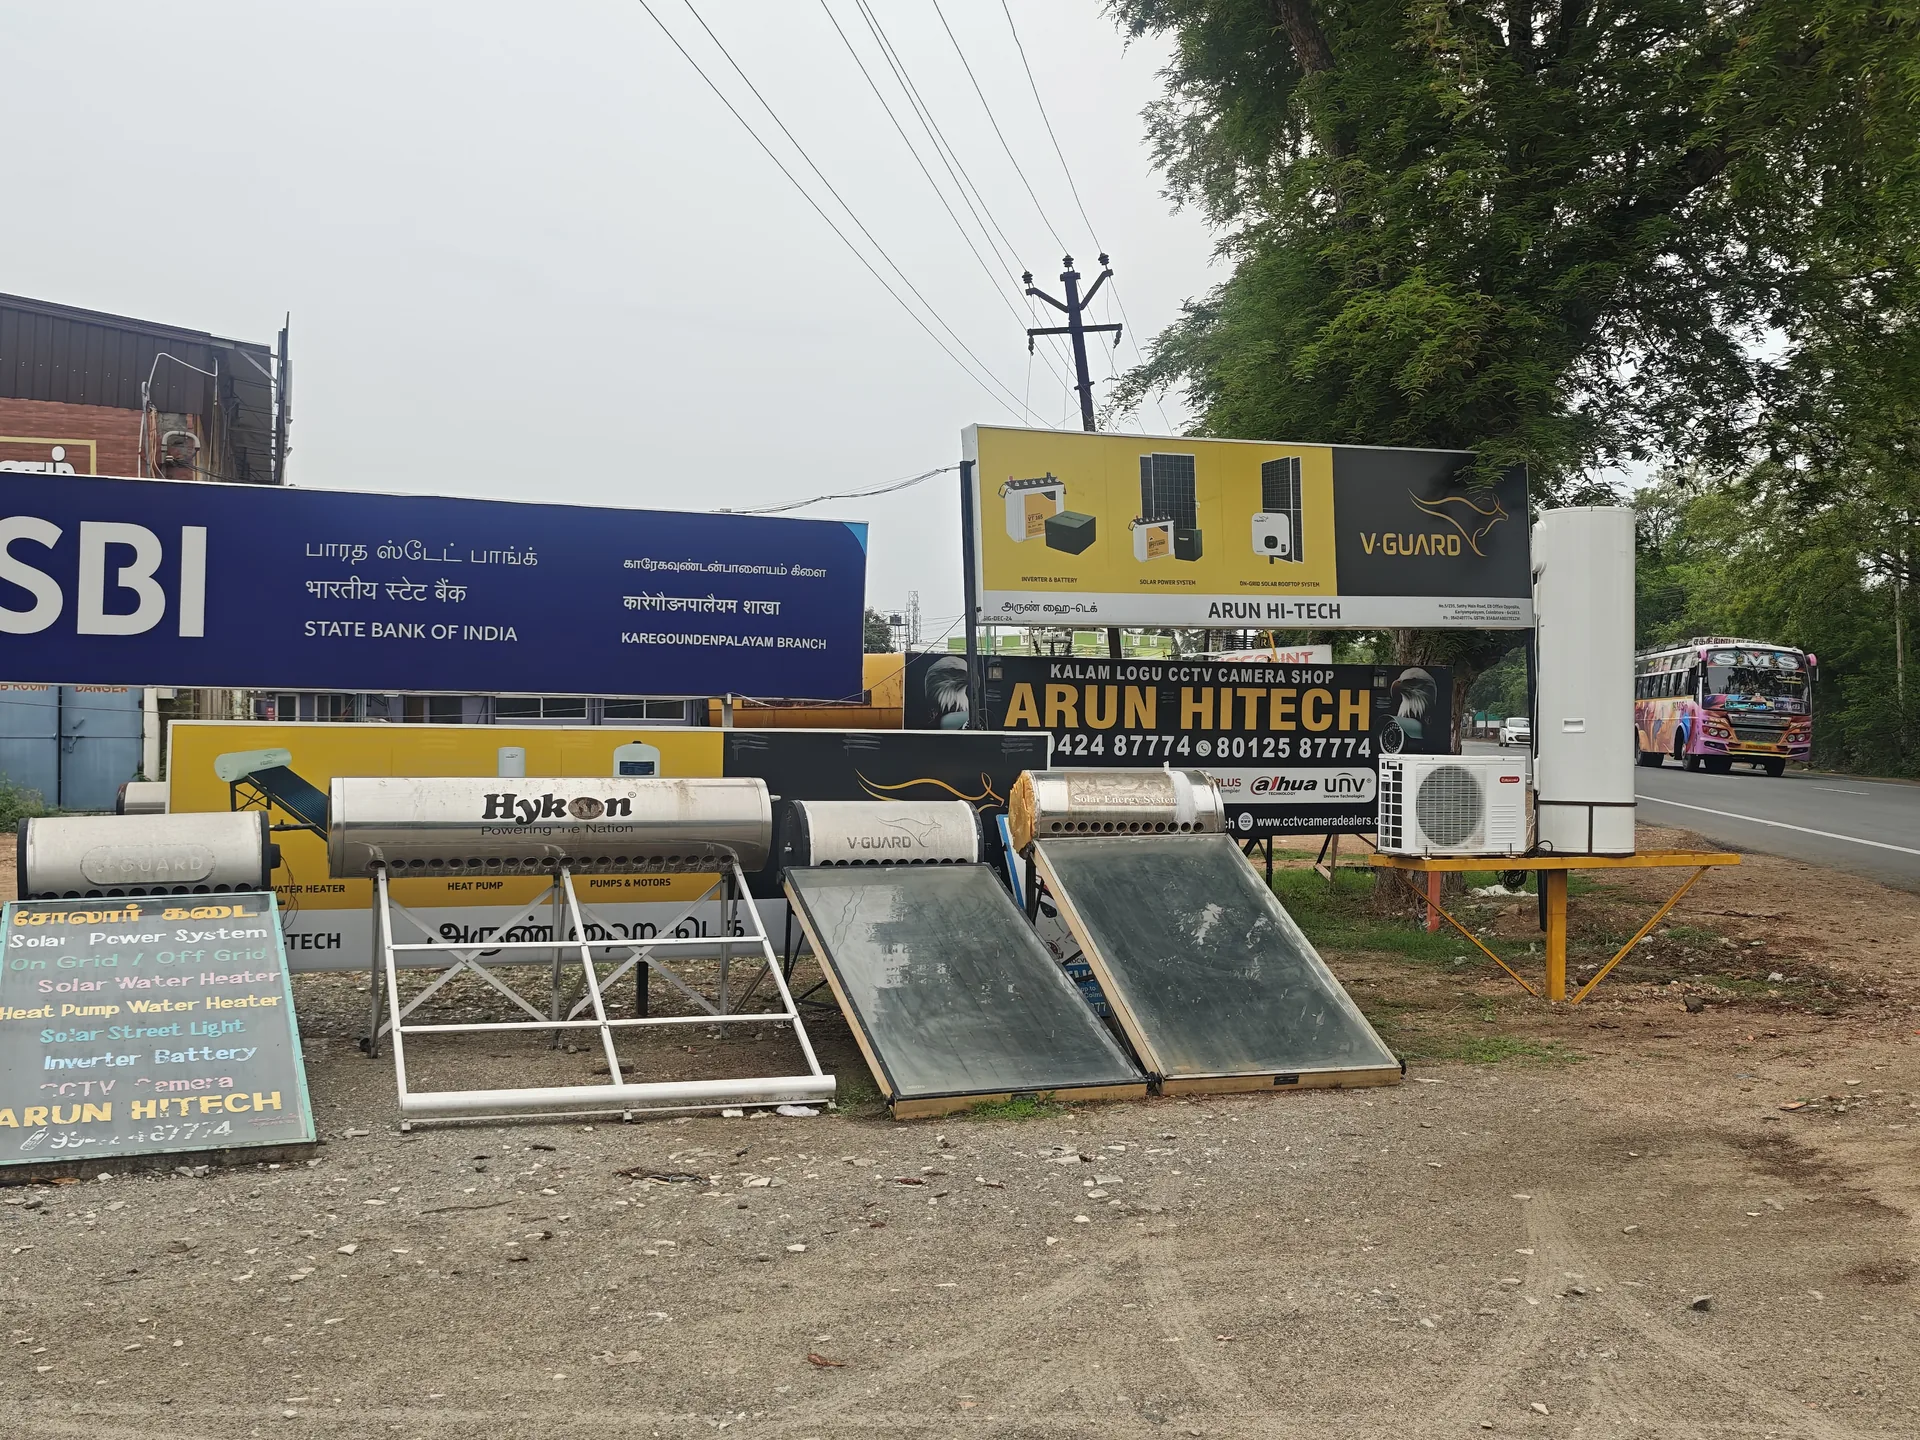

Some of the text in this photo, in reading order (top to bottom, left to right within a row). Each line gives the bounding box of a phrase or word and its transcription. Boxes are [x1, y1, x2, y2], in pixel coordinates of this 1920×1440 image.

[306, 540, 538, 566] பாரத ஸ்டேட் பாங்க்
[1360, 532, 1461, 556] V-GUARD
[0, 516, 207, 637] SBI
[790, 563, 827, 578] கிளை
[305, 575, 468, 603] भारतीय स्टेट बैंक
[743, 599, 781, 615] शाखा
[1001, 600, 1041, 615] அருண்
[1208, 602, 1342, 620] ARUN HI-TECH
[304, 620, 518, 641] STATE BANK OF INDIA
[621, 632, 827, 650] KAREGOUNDENPALAYAM BRANCH
[1050, 663, 1335, 685] KALAM LOGU CCTV CAMERA SHOP
[1003, 682, 1371, 732] ARUN HITECH
[1113, 734, 1191, 758] 87774
[1216, 737, 1291, 758] 80125
[1299, 737, 1371, 759] 87774
[1073, 795, 1101, 804] Solar
[1104, 795, 1141, 806] Energy
[481, 825, 552, 836] Powering
[585, 823, 634, 834] Nation
[846, 836, 912, 849] V-GUARD
[305, 884, 346, 893] HEATER
[447, 881, 504, 891] HEAT PUMP
[590, 878, 671, 888] PUMPS & MOTORS
[162, 904, 258, 920] கடை
[89, 932, 167, 946] Power
[174, 926, 268, 943] System
[10, 947, 268, 971] On Grid / Off Grid
[38, 969, 283, 993] Solar Water Heater
[0, 994, 283, 1020] Heat Pump Water Heater
[107, 1023, 184, 1040] Street
[190, 1018, 247, 1038] Light
[44, 1045, 259, 1070] Inverter Battery
[0, 1101, 113, 1129] ARUN
[130, 1090, 283, 1121] HITECH
